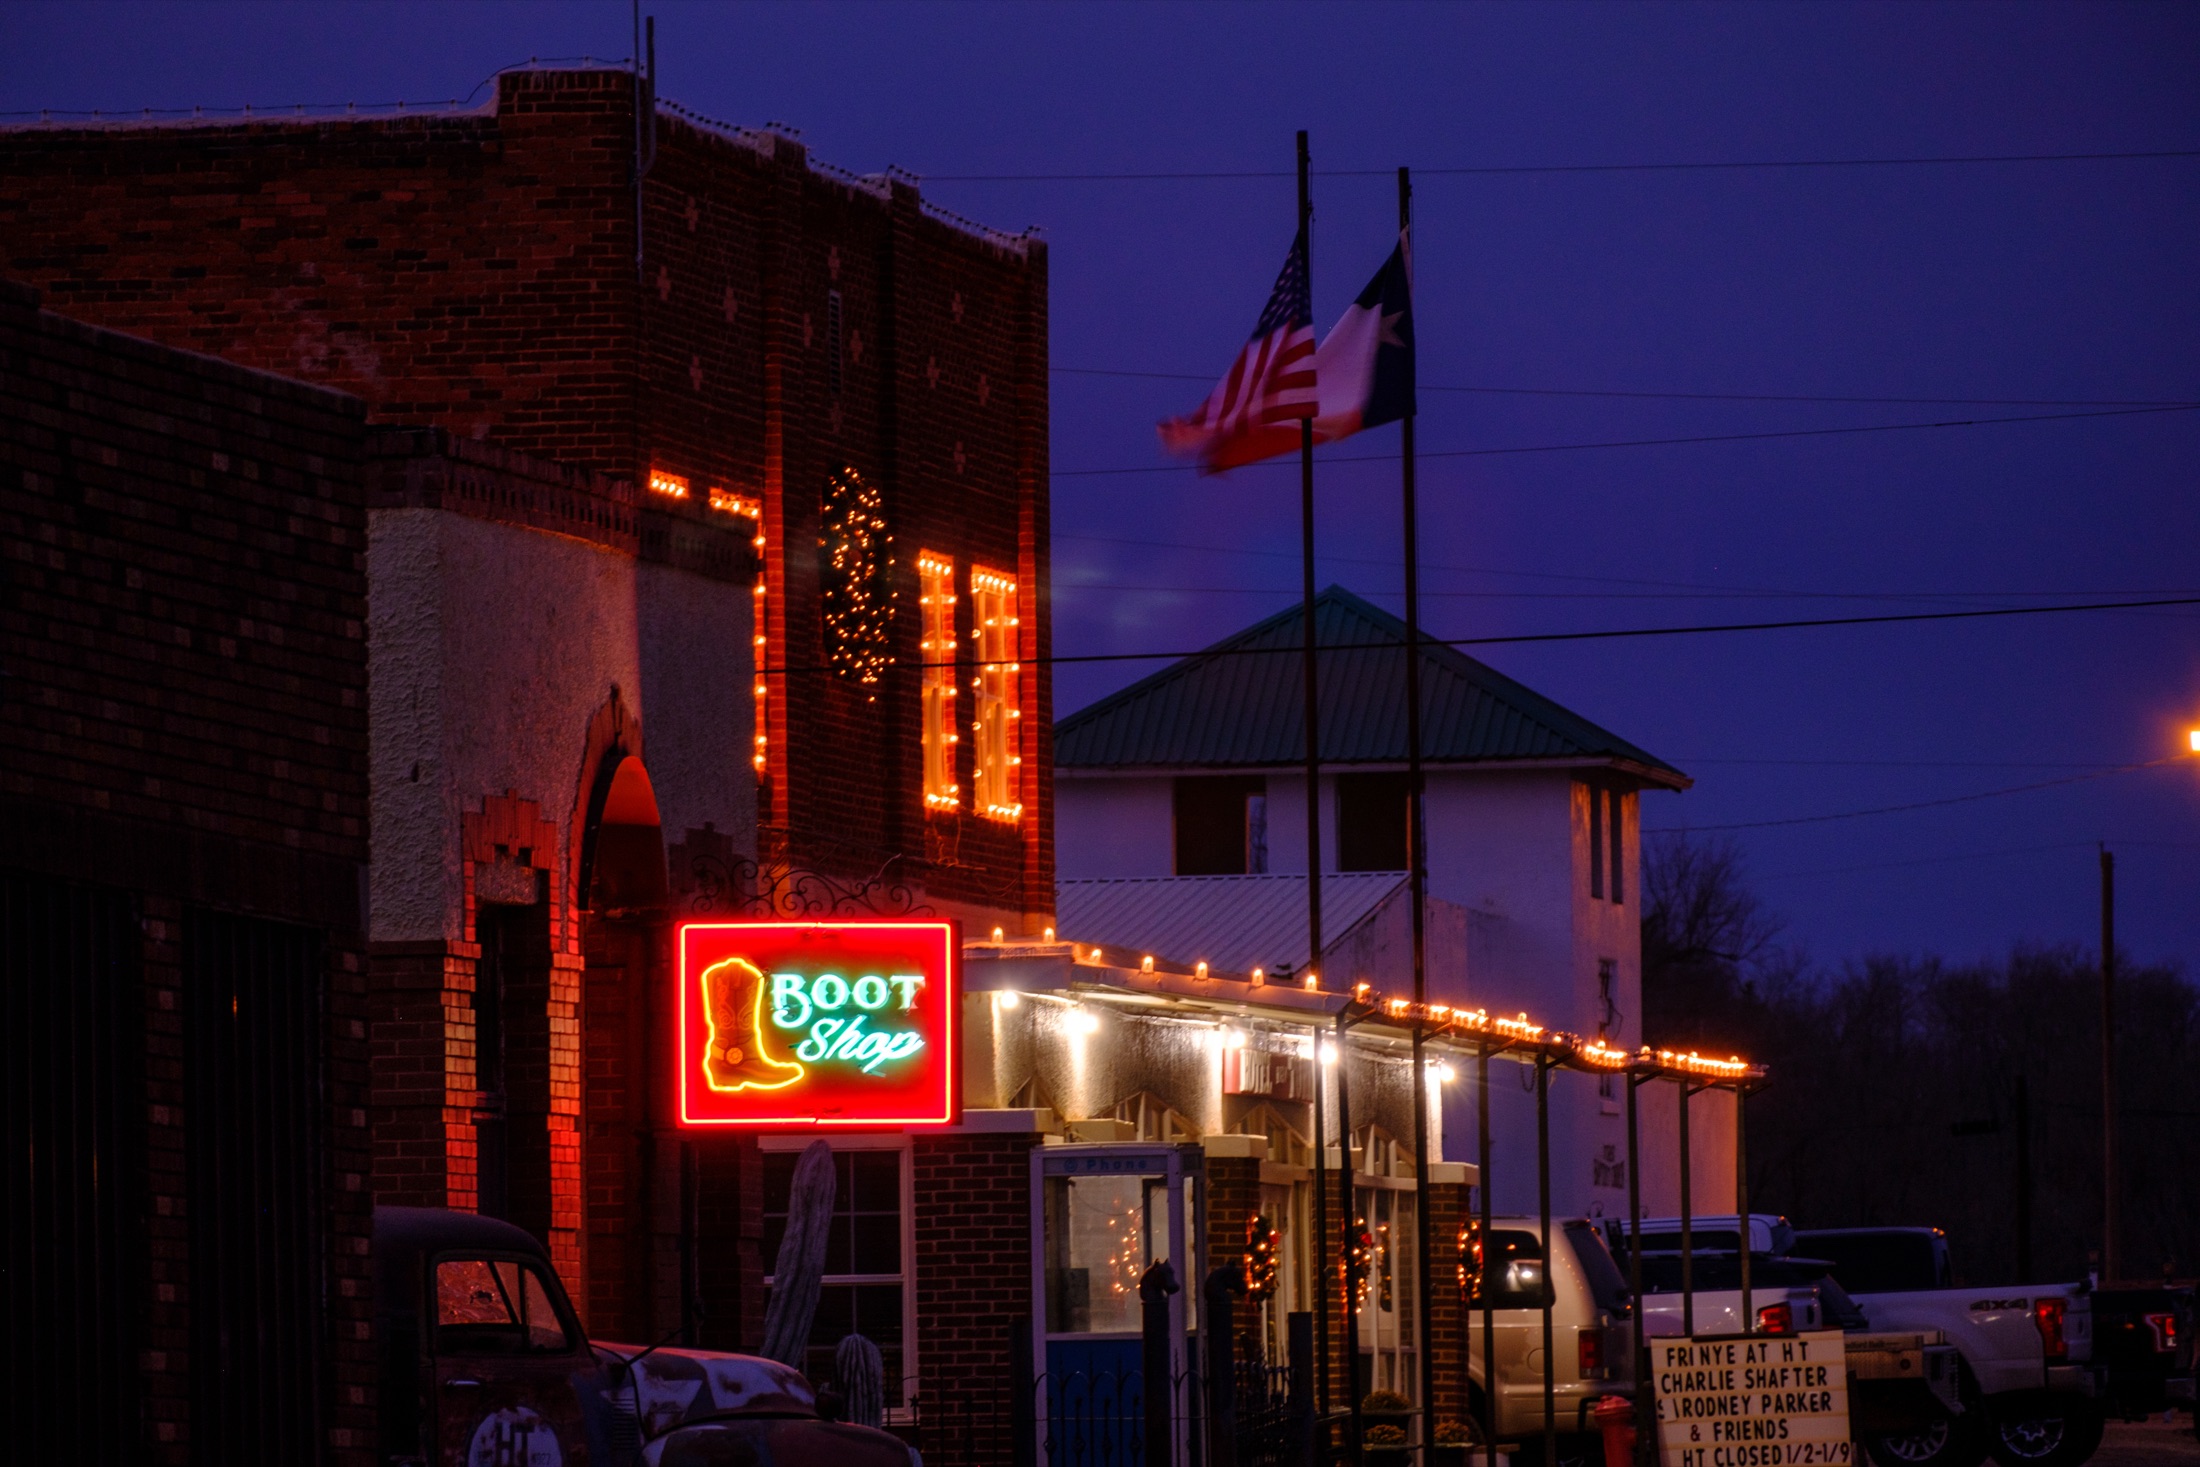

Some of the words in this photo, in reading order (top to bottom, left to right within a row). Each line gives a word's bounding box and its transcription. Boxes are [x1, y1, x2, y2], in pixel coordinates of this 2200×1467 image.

[770, 973, 926, 1028] BOOT
[796, 1014, 925, 1073] Shop
[1086, 1158, 1147, 1170] Phone
[1700, 1344, 1736, 1366] NYE
[1746, 1343, 1768, 1364] AT
[1661, 1370, 1735, 1394] CHARLIE
[1745, 1366, 1827, 1389] SHAFTER
[1762, 1391, 1832, 1414] PARKER
[1690, 1424, 1701, 1442] &
[1713, 1418, 1789, 1441] FRIENDS
[1683, 1448, 1705, 1467] HT
[1714, 1444, 1782, 1467] CLOSED
[1786, 1441, 1850, 1464] 1/2-1/9
